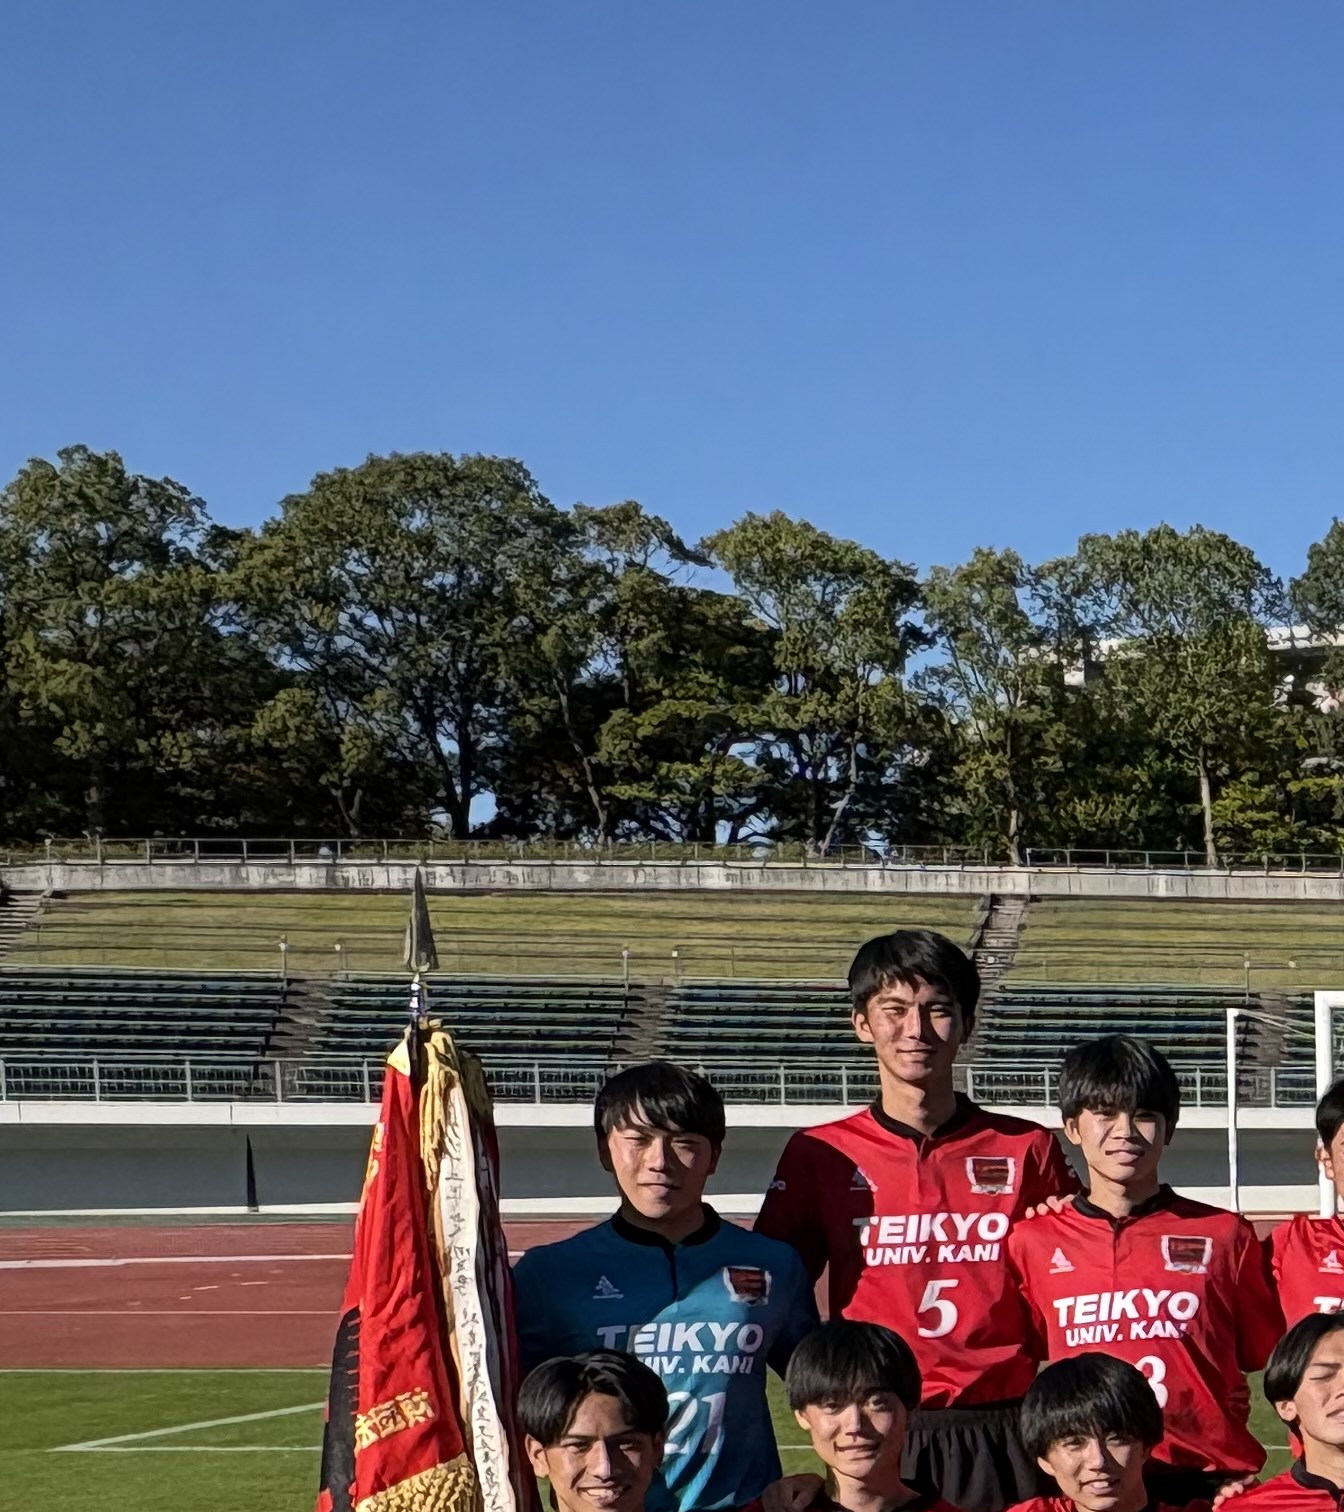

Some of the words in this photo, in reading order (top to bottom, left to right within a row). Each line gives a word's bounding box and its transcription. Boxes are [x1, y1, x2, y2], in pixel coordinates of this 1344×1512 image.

[853, 1213, 1009, 1246] TEIKYO
[866, 1246, 931, 1267] UNIV.
[937, 1242, 1000, 1263] KANI
[918, 1279, 959, 1338] 5
[1053, 1289, 1199, 1328] TEIKYO
[597, 1322, 765, 1352] TEIKYO
[1065, 1323, 1123, 1347] UNIV.
[1129, 1320, 1186, 1340] KANI
[693, 1355, 753, 1374] KANI
[664, 1392, 726, 1453] 21
